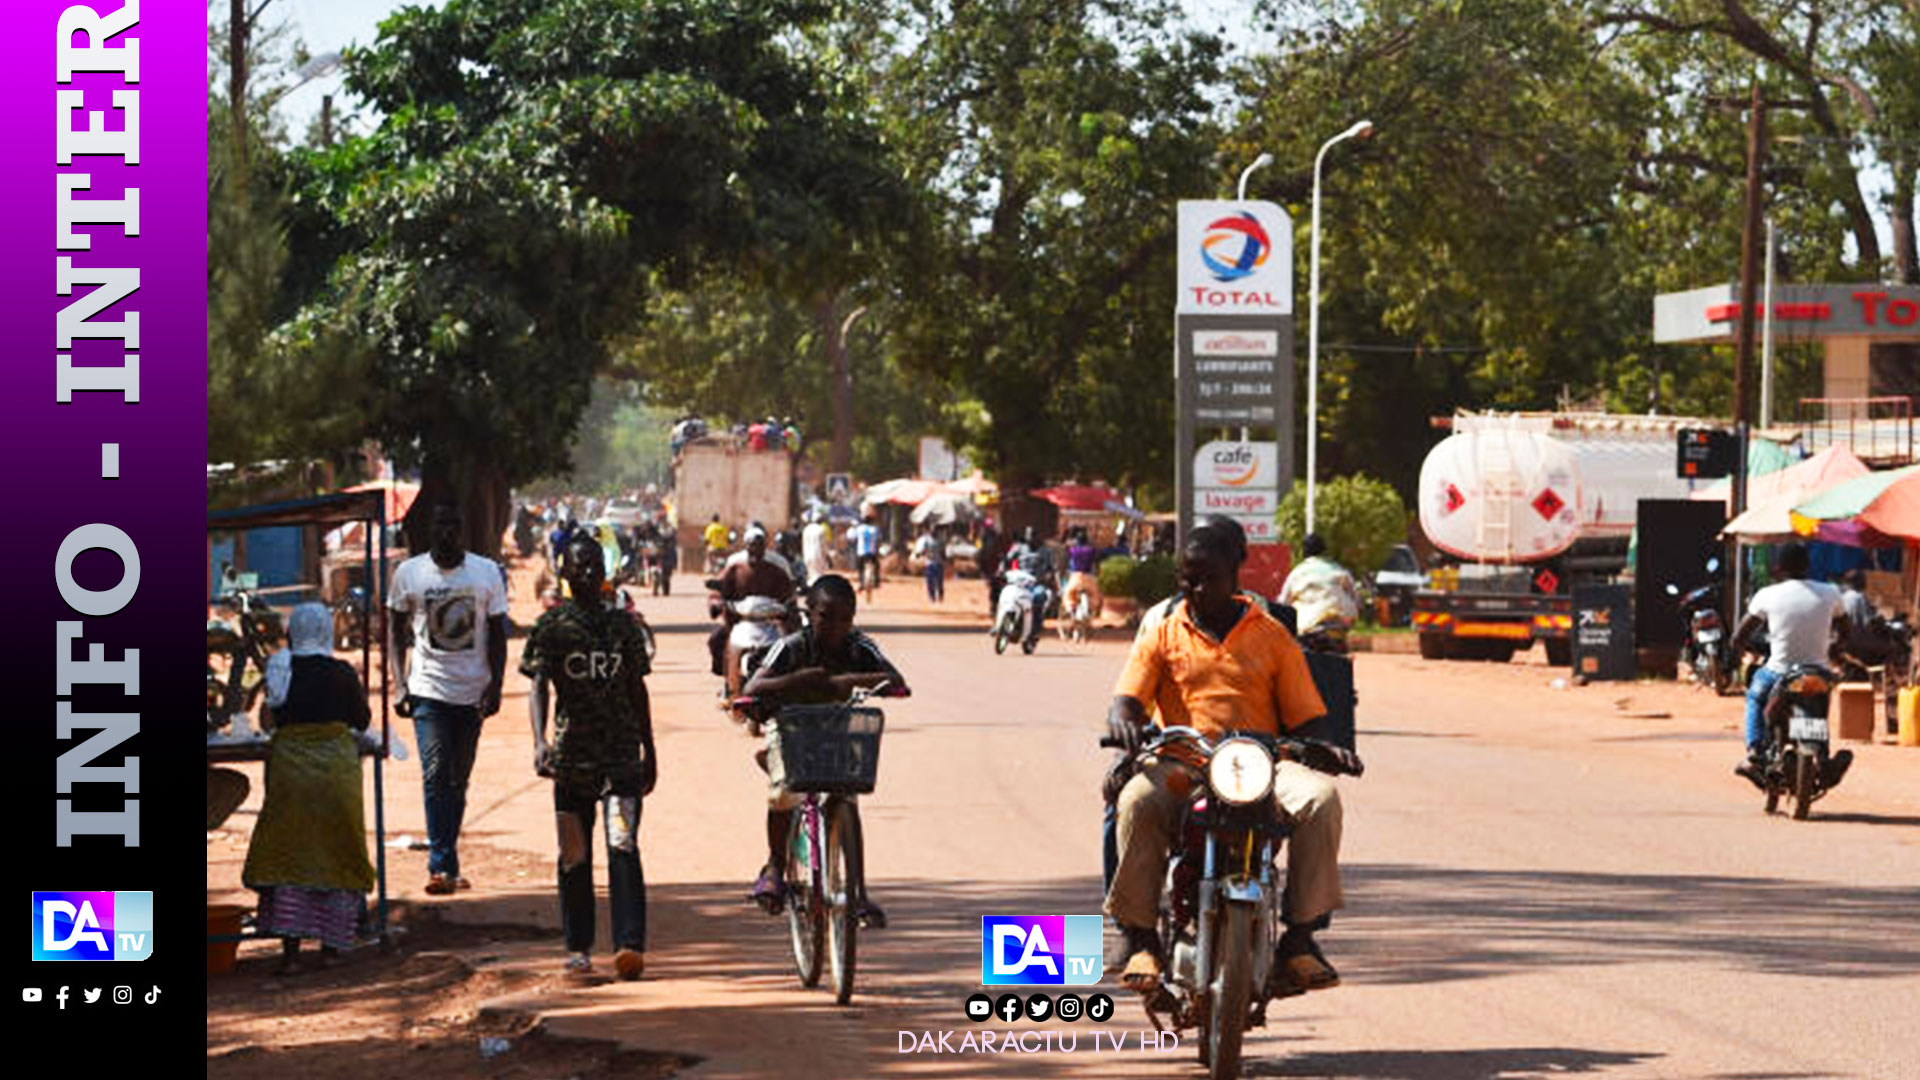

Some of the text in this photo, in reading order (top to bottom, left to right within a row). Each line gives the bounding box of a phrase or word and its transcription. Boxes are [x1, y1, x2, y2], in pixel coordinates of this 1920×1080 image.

[1190, 286, 1281, 306] TOTAL
[1213, 446, 1252, 463] café
[1205, 492, 1265, 512] lavage
[564, 652, 622, 679] CR7
